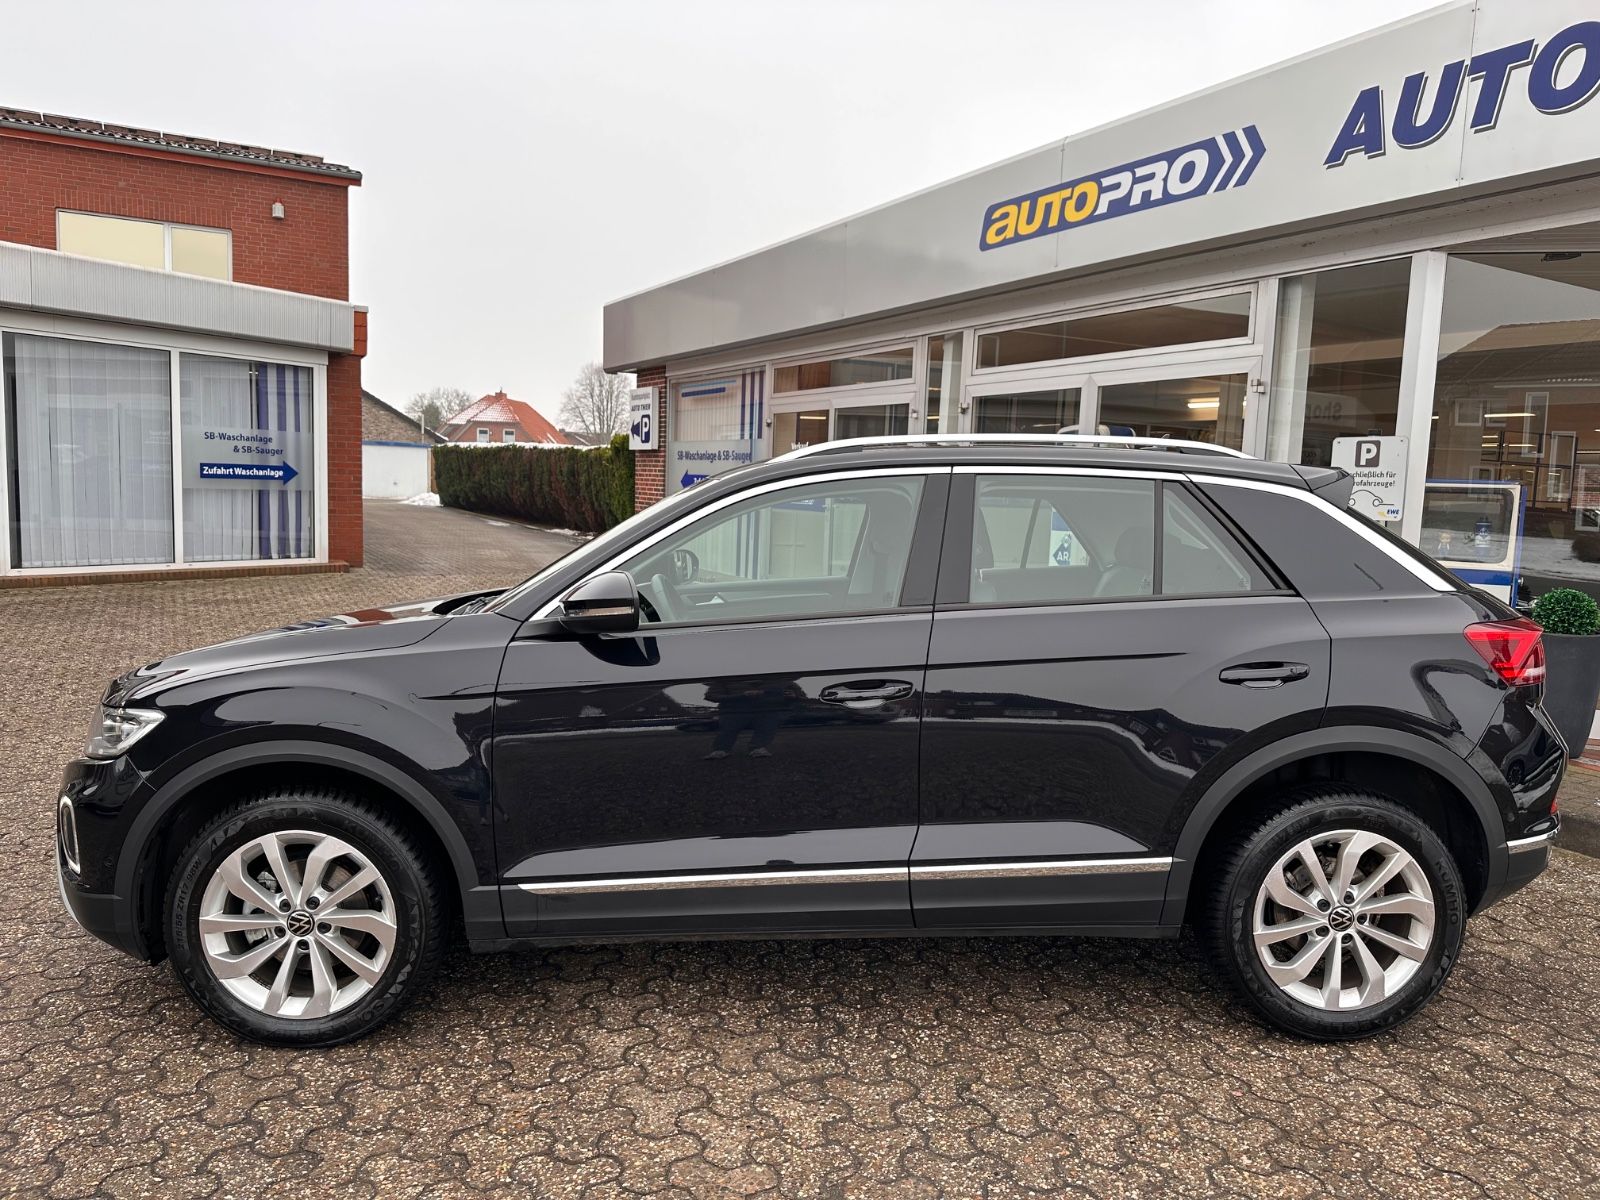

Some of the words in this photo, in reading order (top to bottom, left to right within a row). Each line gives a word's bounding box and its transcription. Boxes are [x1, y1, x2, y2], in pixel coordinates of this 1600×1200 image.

[1322, 21, 1600, 168] AUTO
[641, 417, 650, 441] P
[204, 431, 273, 444] SB-Waschanlage
[233, 445, 240, 453] &
[241, 445, 284, 456] SB-Sauger
[677, 450, 717, 463] SB-Waschanlage
[717, 450, 722, 461] &
[1359, 442, 1378, 466] P
[202, 466, 234, 476] Zufahrt
[234, 467, 284, 478] Waschanlage
[1386, 470, 1396, 478] für
[1353, 479, 1395, 489] rofahrzeuge!
[1056, 551, 1070, 561] AR
